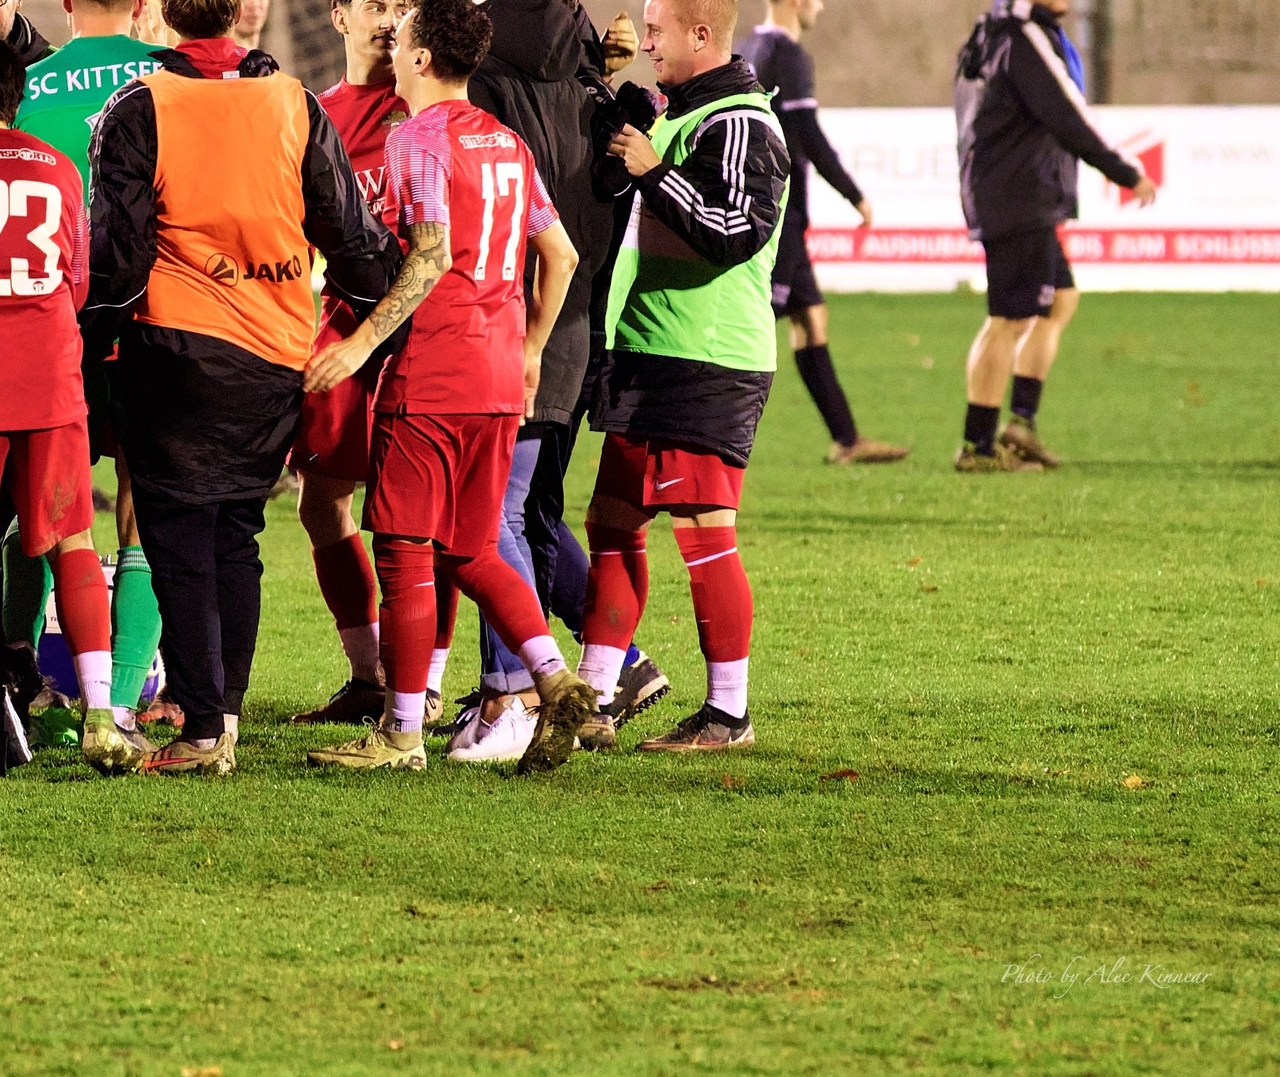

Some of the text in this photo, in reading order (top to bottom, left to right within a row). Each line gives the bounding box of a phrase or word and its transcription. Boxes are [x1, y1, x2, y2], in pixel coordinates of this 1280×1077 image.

[28, 72, 58, 100] SC
[474, 162, 524, 281] 17
[243, 255, 302, 283] JAKO
